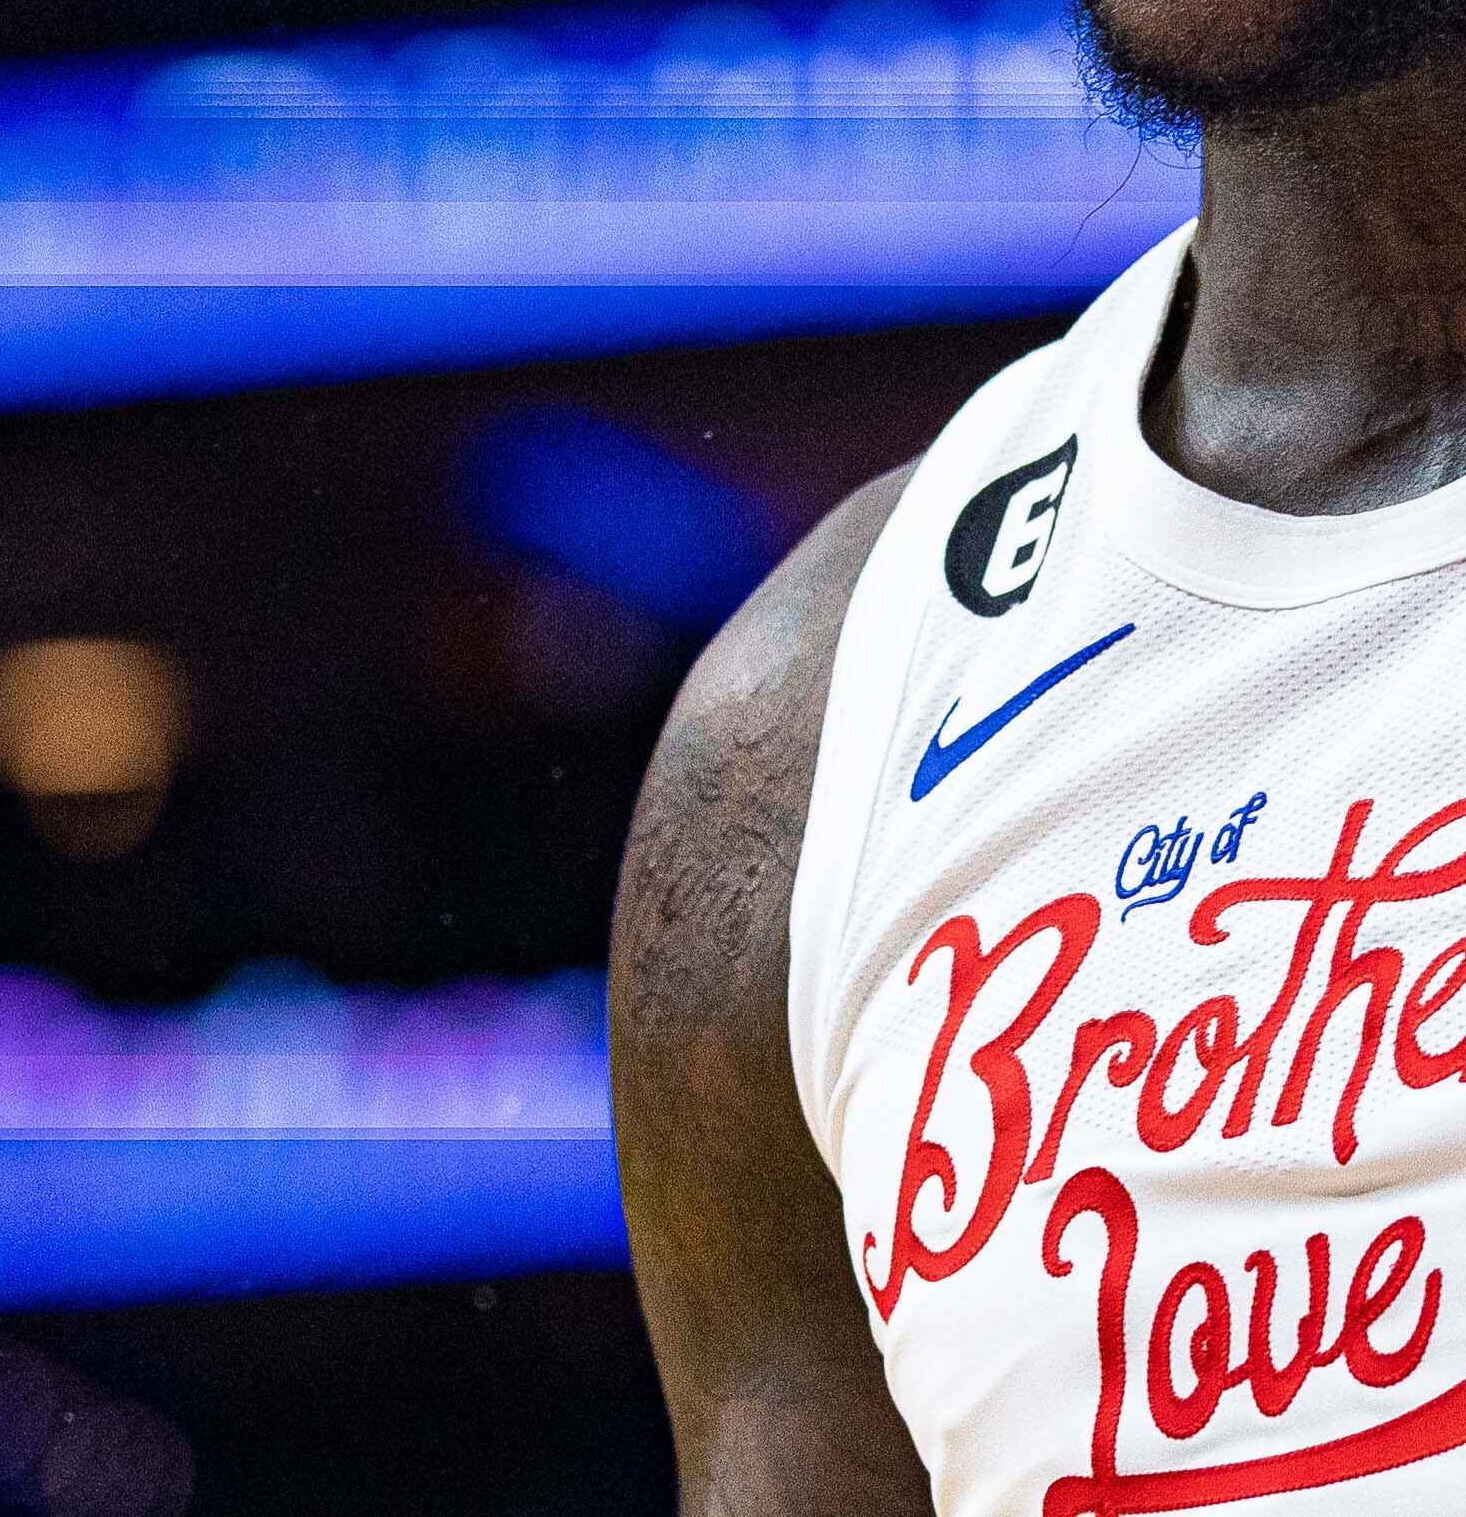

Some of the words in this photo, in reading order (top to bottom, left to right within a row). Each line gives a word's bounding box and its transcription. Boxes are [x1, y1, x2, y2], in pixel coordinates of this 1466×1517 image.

[977, 457, 1072, 602] 6
[1115, 815, 1205, 924] City
[1211, 791, 1268, 864] of
